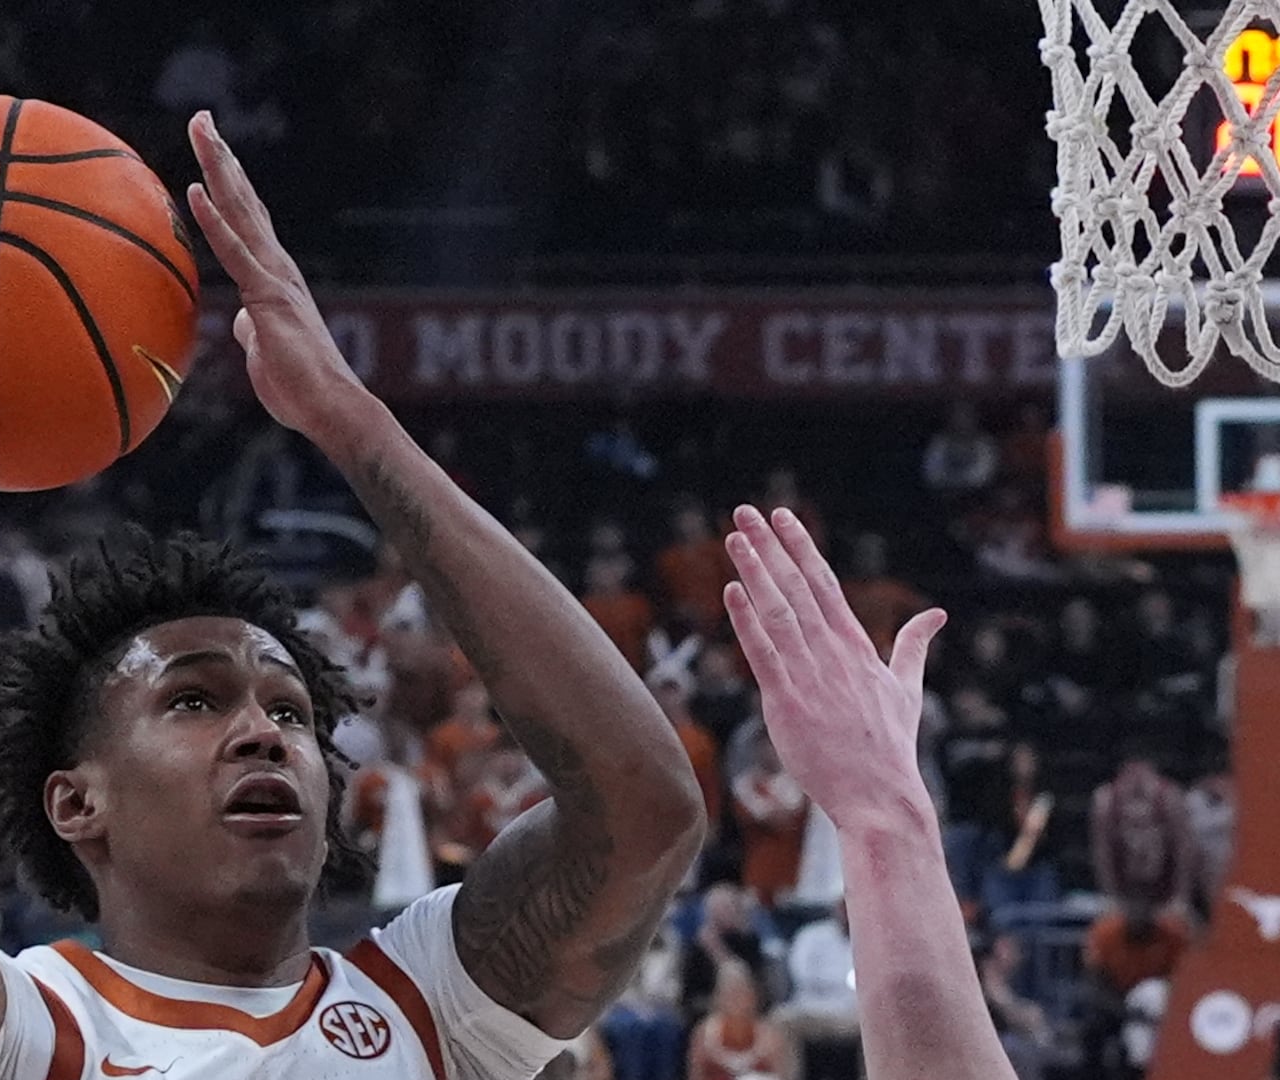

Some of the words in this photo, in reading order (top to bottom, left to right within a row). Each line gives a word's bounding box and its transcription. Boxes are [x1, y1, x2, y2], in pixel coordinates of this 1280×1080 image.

[415, 310, 728, 382] MOODY
[762, 311, 1072, 384] CENTE
[321, 1002, 390, 1058] SEC
